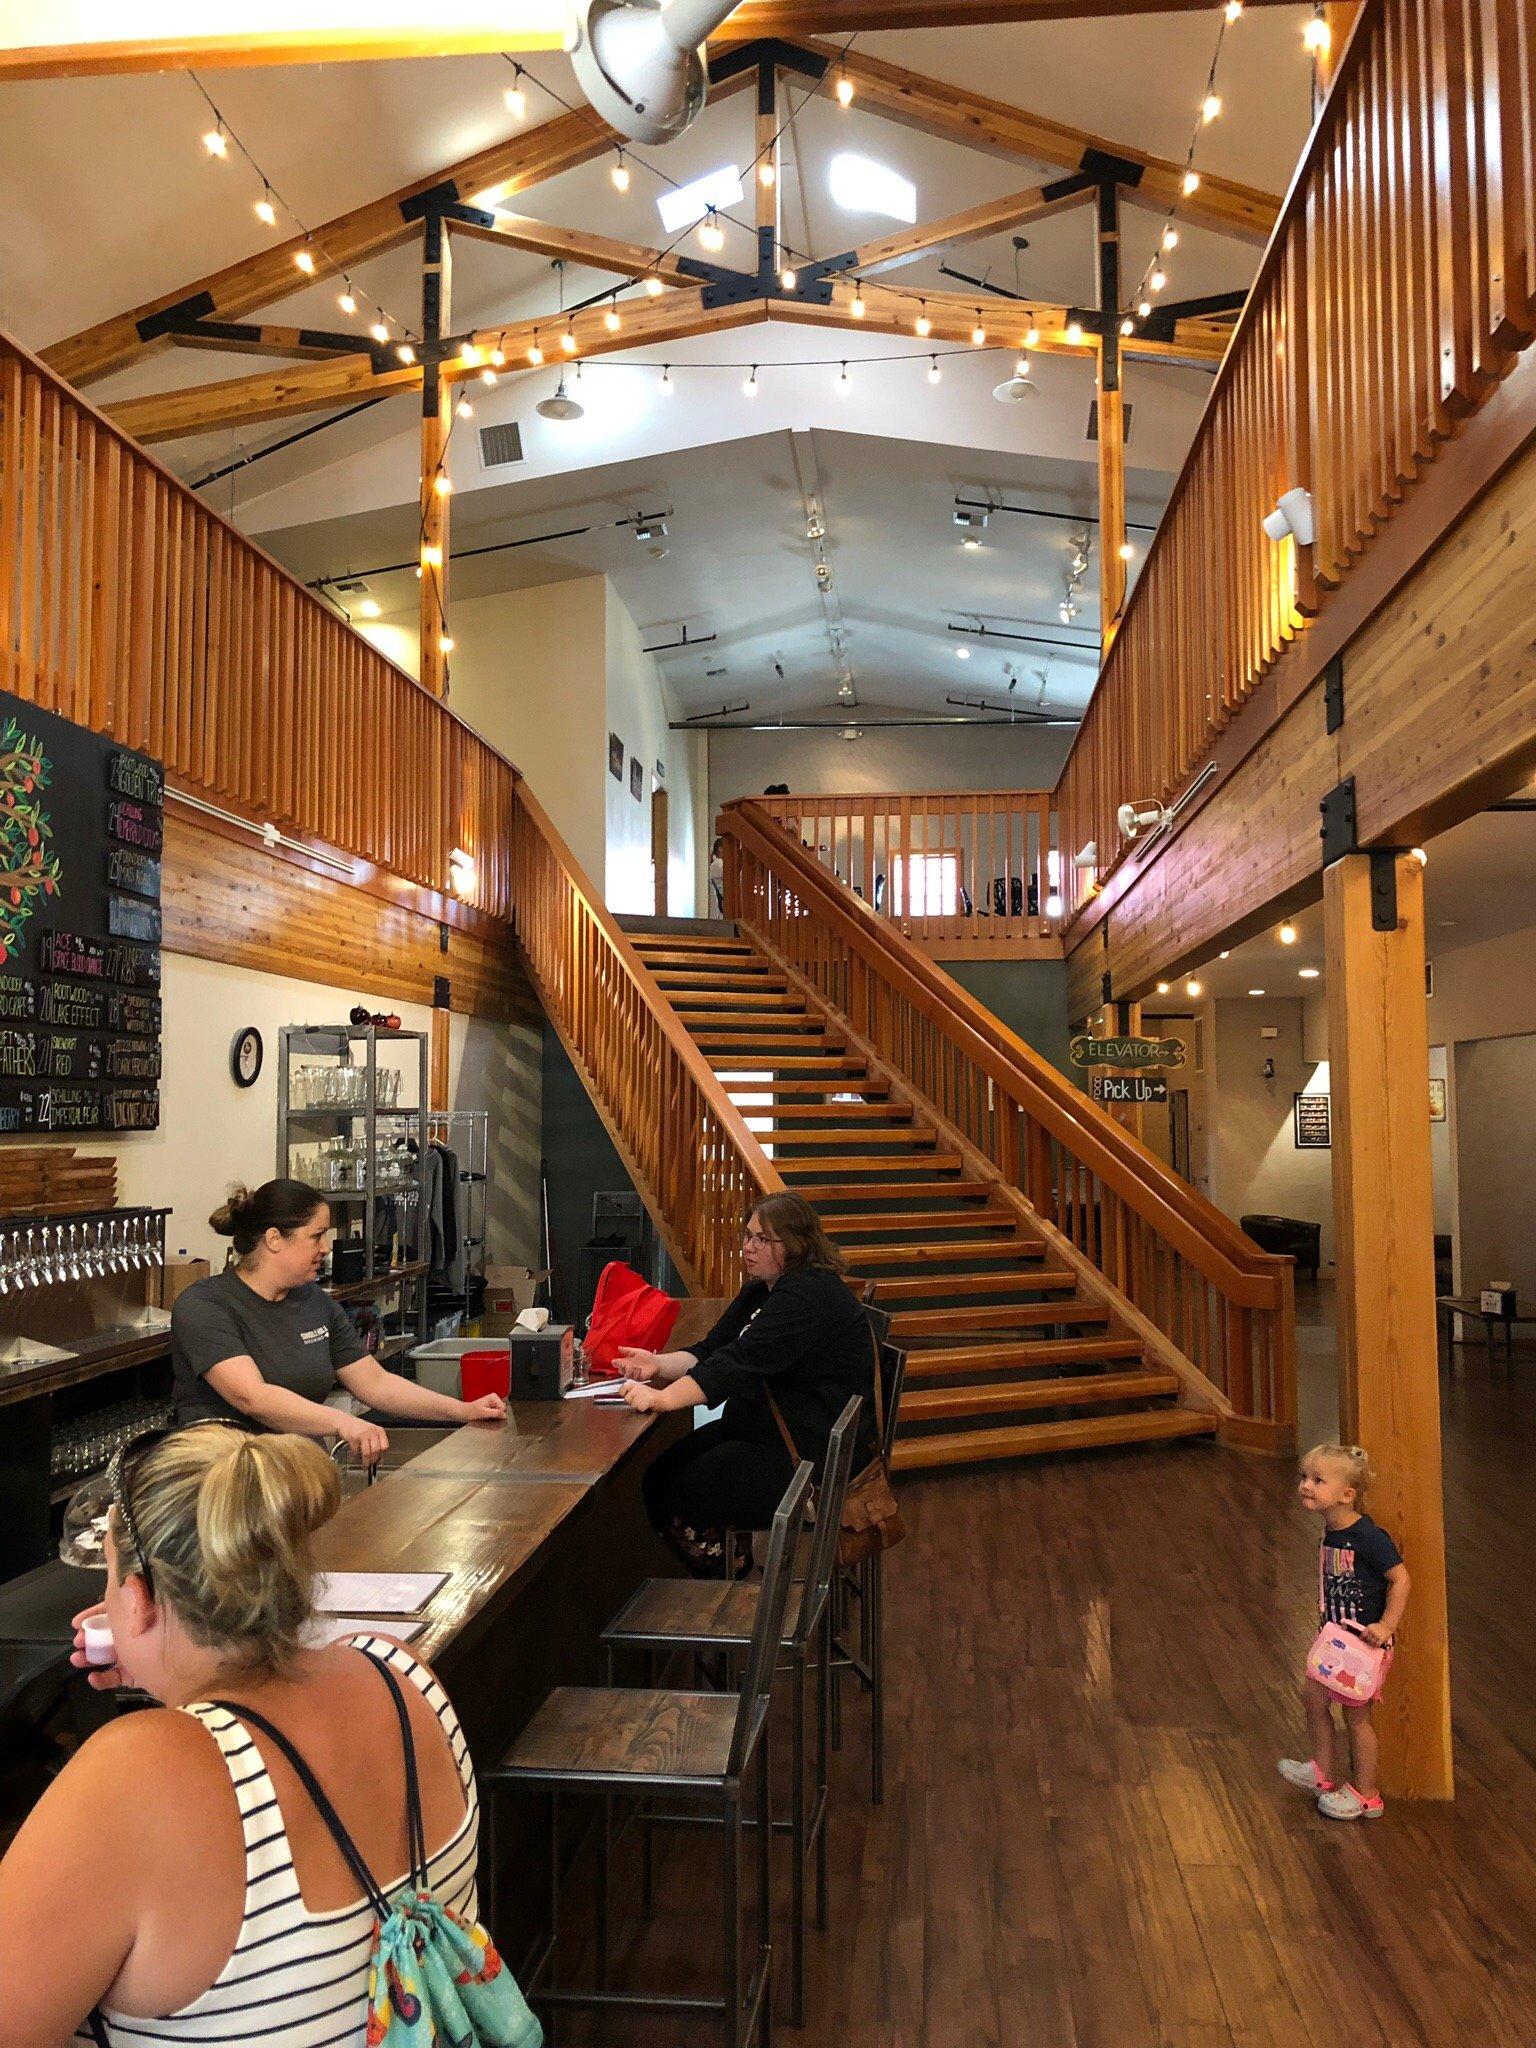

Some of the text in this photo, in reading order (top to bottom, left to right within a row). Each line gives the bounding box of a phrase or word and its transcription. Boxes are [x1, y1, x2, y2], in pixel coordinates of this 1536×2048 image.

[55, 933, 72, 950] ACE
[53, 1004, 70, 1025] LAKE
[71, 1005, 100, 1027] EFFECT
[1088, 1042, 1160, 1058] ELEVATOR
[55, 1053, 72, 1076] RED
[1104, 1079, 1152, 1101] Pick Up
[38, 1093, 50, 1123] 22
[83, 1106, 99, 1125] PEAR
